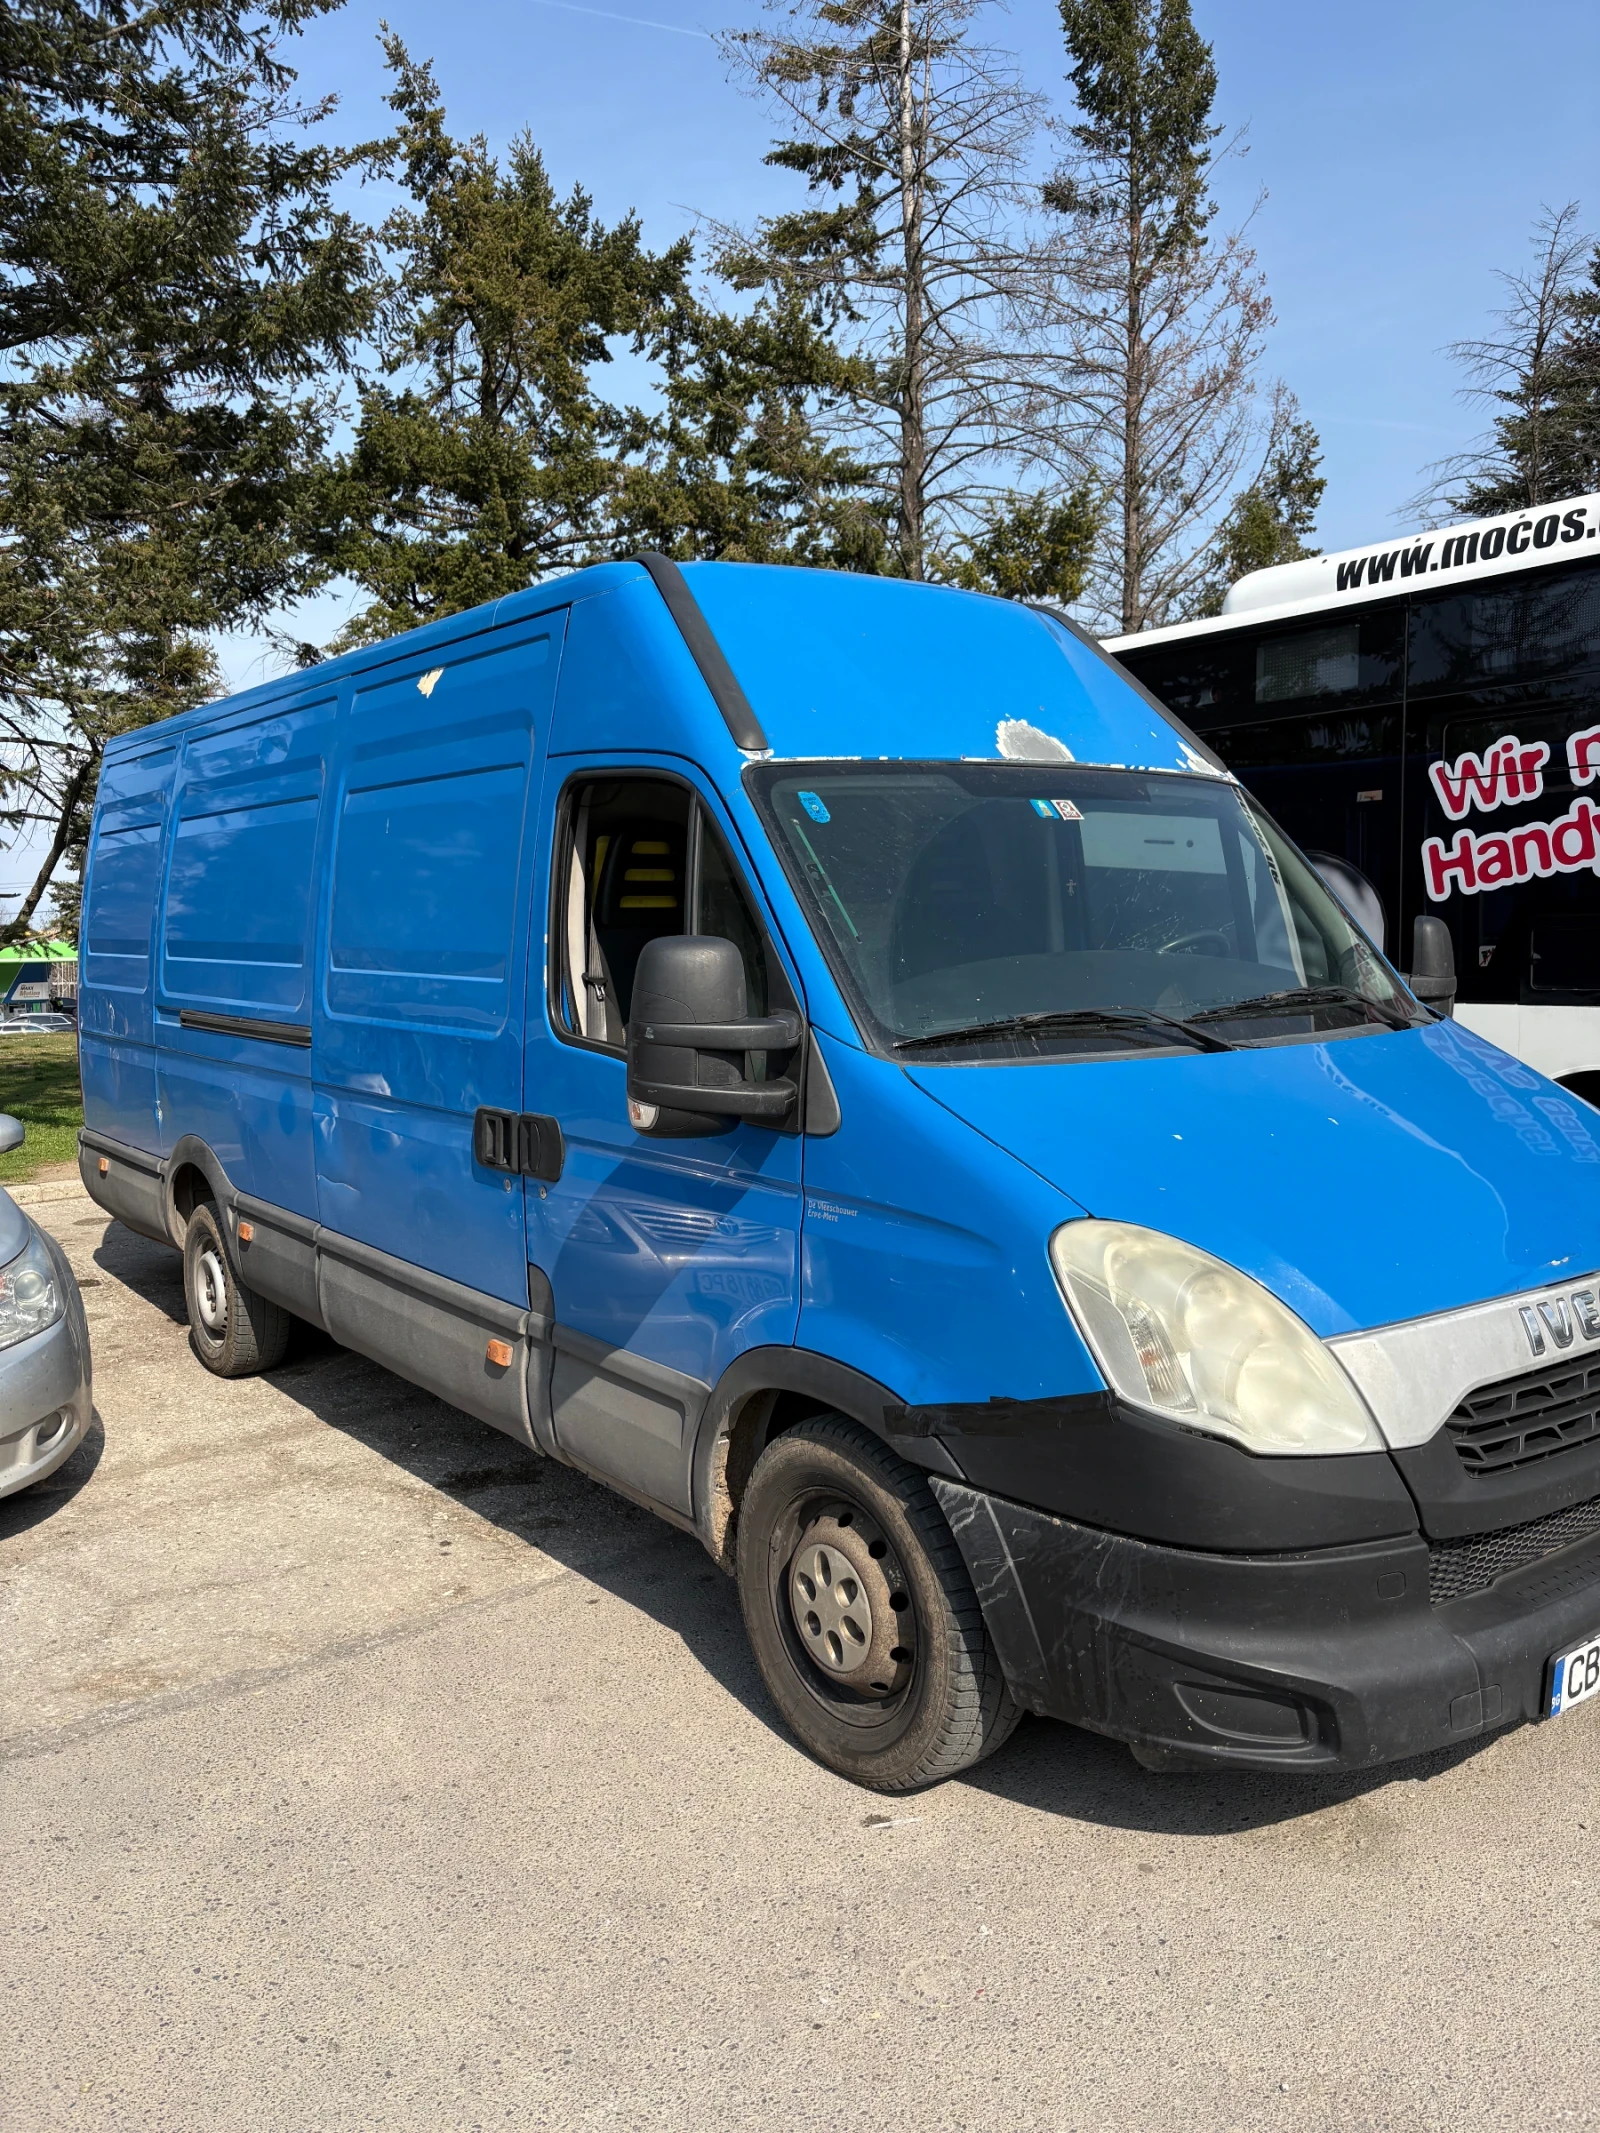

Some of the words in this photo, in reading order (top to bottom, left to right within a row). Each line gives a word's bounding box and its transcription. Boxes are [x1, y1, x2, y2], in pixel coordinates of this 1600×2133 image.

[1336, 507, 1600, 592] www.mocos.
[1433, 740, 1545, 815] Wir
[1426, 802, 1600, 896] Hand
[1518, 1289, 1600, 1357] IVE
